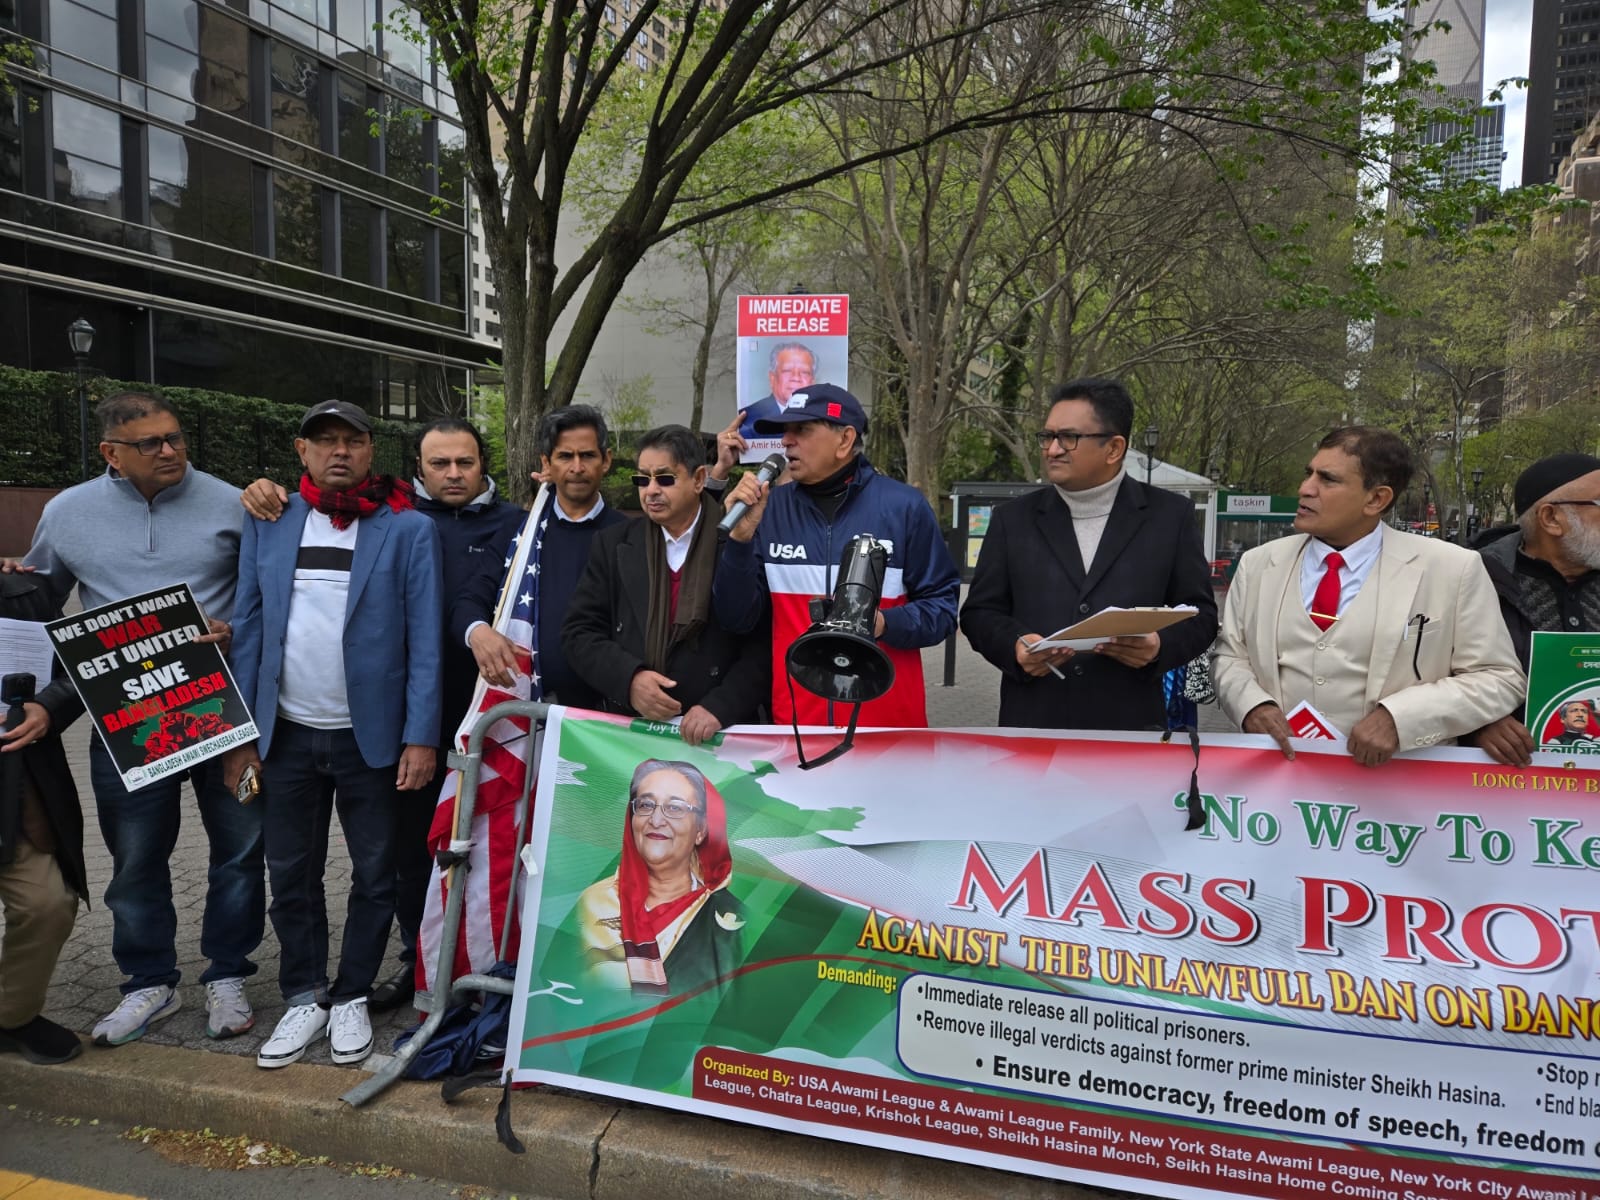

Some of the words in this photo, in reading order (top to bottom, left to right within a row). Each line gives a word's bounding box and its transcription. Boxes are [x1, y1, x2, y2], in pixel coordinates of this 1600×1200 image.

[749, 299, 841, 314] IMMEDIATE
[756, 318, 830, 333] RELEASE
[751, 440, 769, 449] Amir
[769, 542, 807, 560] USA
[52, 622, 85, 643] WE
[84, 604, 136, 633] DON'T
[138, 590, 188, 615] WANT
[96, 614, 163, 649] WAR
[77, 651, 119, 680] GET
[123, 624, 201, 664] UNITED
[141, 660, 155, 671] TO
[102, 671, 228, 734] BANGLADESH
[122, 660, 190, 701] SAVE
[147, 756, 184, 778] BANGLADESH
[182, 748, 201, 763] AWAMI
[236, 724, 257, 742] LEAGUE
[646, 722, 667, 734] Joy
[1472, 772, 1526, 789] LONG
[1531, 775, 1579, 792] LIVE
[1293, 799, 1427, 866] Way
[1436, 812, 1515, 866] To
[948, 841, 1260, 946] MASS
[817, 961, 897, 994] Demanding:
[857, 908, 1007, 967] AGANIST
[1020, 935, 1092, 980] THE
[1097, 946, 1324, 1011] UNLAWFULL
[1325, 969, 1417, 1022] BAN
[1423, 983, 1492, 1030] ON
[1008, 998, 1065, 1021] release
[1070, 1005, 1089, 1024] all
[1093, 1010, 1159, 1036] political
[1164, 1020, 1252, 1048] prisoners.
[990, 1021, 1036, 1046] illegal
[1041, 1032, 1105, 1056] verdicts
[1111, 1040, 1172, 1065] against
[1177, 1049, 1234, 1075] former
[1238, 1060, 1289, 1083] prime
[1293, 1065, 1367, 1091] minister
[1371, 1073, 1432, 1100] Sheikh
[1438, 1081, 1506, 1108] Hasina.
[702, 1056, 769, 1081] Organized
[772, 1072, 795, 1087] By:
[799, 1075, 830, 1092] USA
[831, 1081, 879, 1100] Awami
[882, 1089, 935, 1111] League
[939, 1099, 951, 1113] &
[953, 1102, 1004, 1122] Awami
[1008, 1111, 1065, 1132] League
[1129, 1131, 1164, 1149] New
[1168, 1137, 1205, 1156] York
[1210, 1143, 1252, 1162] State
[1255, 1150, 1313, 1171] Awami
[1317, 1158, 1385, 1183] League,
[1390, 1168, 1428, 1187] New
[1432, 1173, 1473, 1193] York
[993, 1054, 1071, 1088] Ensure
[1078, 1070, 1216, 1115] democracy,
[1223, 1090, 1327, 1126] freedom
[1334, 1107, 1361, 1129] of
[1368, 1114, 1469, 1148] speech,
[1477, 1122, 1586, 1157] freedom
[704, 1075, 755, 1098] League,
[758, 1086, 803, 1106] Chatra
[807, 1095, 861, 1117] League,
[865, 1106, 921, 1126] Krishok
[925, 1117, 983, 1139] League,
[987, 1126, 1040, 1147] Sheikh
[1044, 1137, 1098, 1157] Hasina
[1102, 1145, 1161, 1168] Monch,
[1165, 1156, 1211, 1174] Seikh
[1215, 1163, 1272, 1185] Hasina
[1277, 1172, 1327, 1192] Home
[1331, 1180, 1398, 1200] Coming
